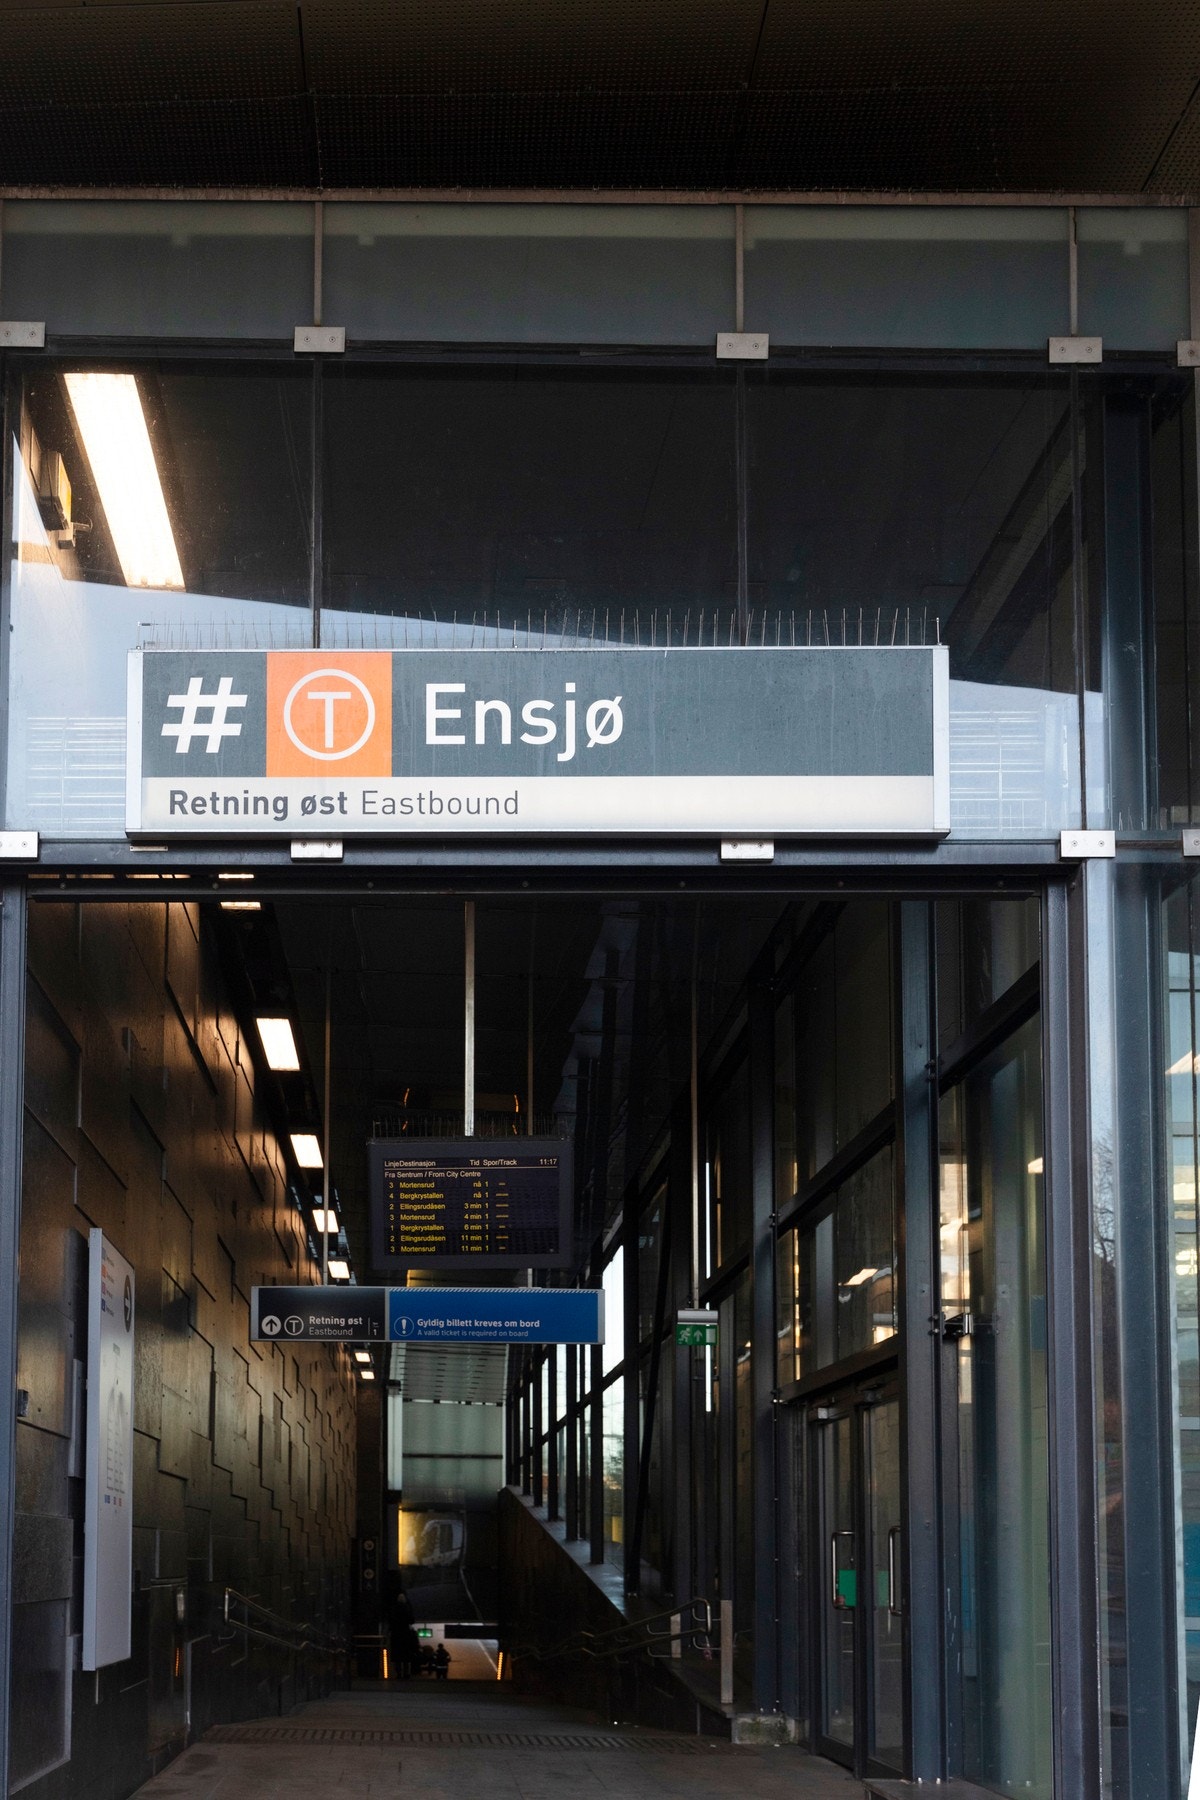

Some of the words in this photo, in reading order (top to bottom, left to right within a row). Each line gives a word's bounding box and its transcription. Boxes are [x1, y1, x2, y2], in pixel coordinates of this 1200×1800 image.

[425, 682, 623, 762] Ensjø
[169, 790, 289, 821] Retning
[300, 791, 348, 816] øst
[362, 790, 519, 815] Eastbound
[446, 1171, 459, 1179] City
[460, 1170, 481, 1178] Centre
[309, 1315, 345, 1326] Retning
[348, 1317, 363, 1325] øst
[417, 1318, 445, 1328] Gyldig
[446, 1318, 472, 1327] billett
[474, 1319, 502, 1328] kreves
[519, 1319, 540, 1328] bord
[309, 1327, 353, 1336] Eastbound
[461, 1329, 467, 1337] is
[468, 1330, 497, 1338] required
